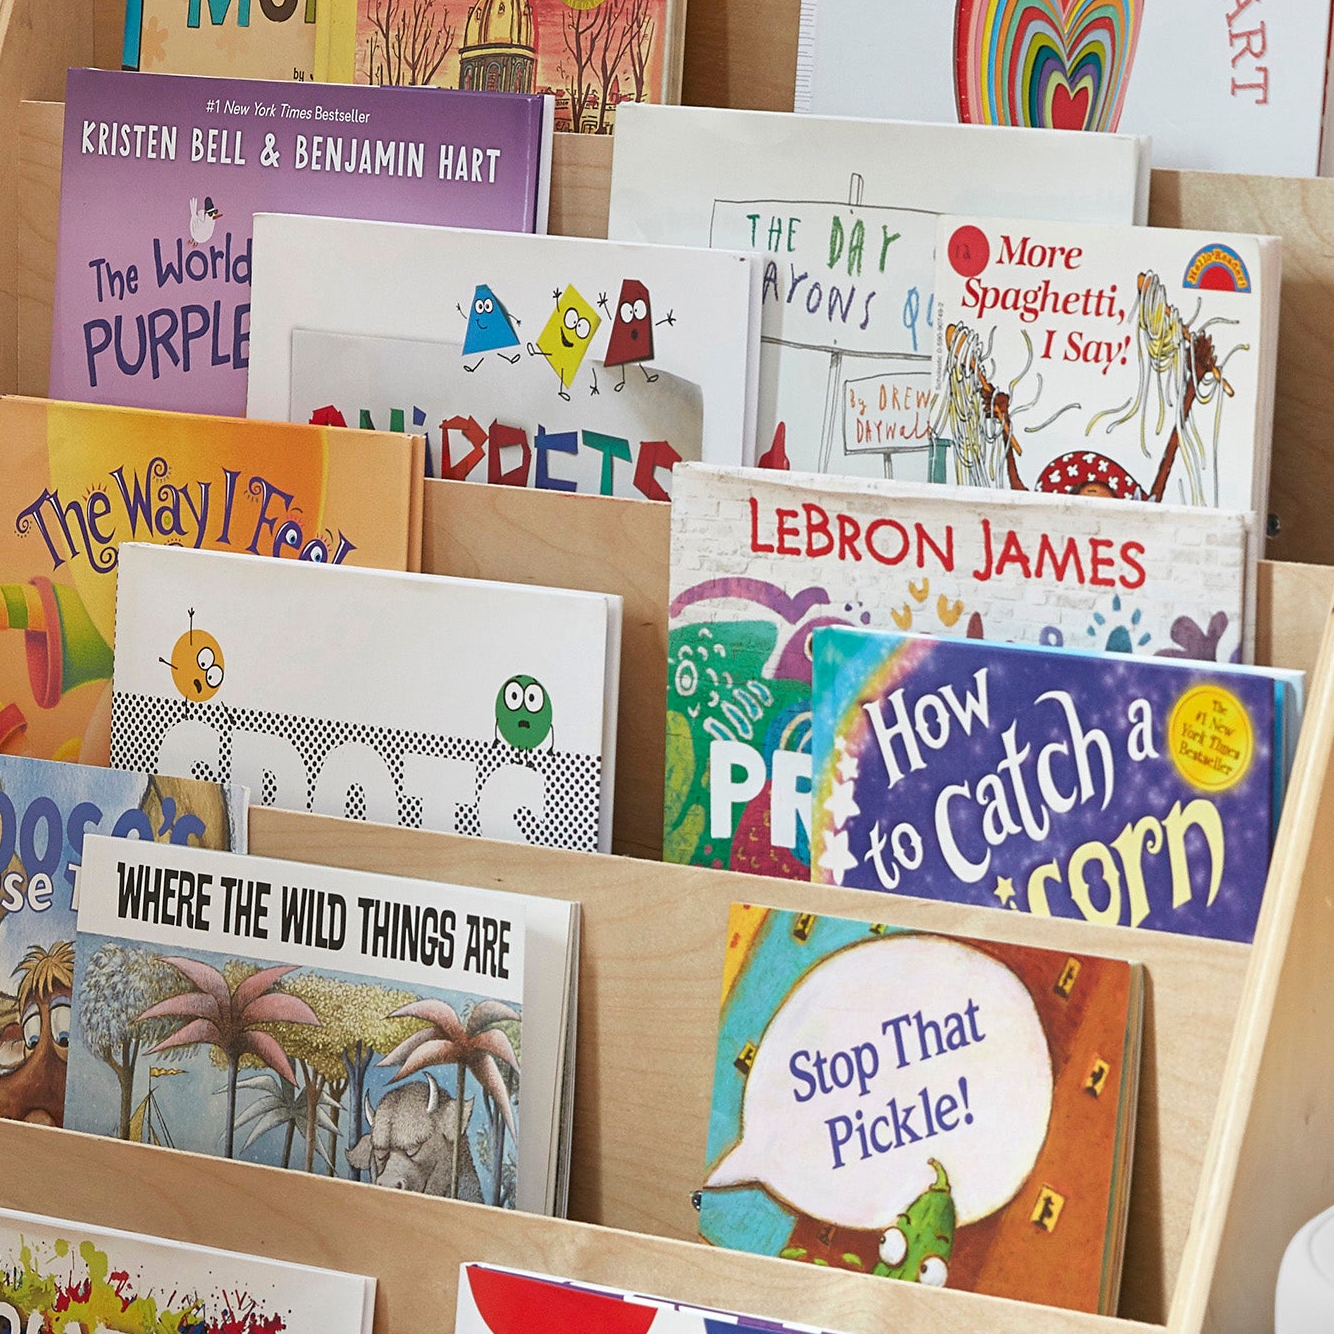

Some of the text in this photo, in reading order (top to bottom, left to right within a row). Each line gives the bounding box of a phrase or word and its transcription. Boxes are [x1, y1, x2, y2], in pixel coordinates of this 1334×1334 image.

[206, 99, 371, 124] #1 New York Times Bestseller
[293, 67, 305, 82] by
[81, 120, 501, 184] KRISTEN BELL & BENJAMIN HART
[89, 232, 253, 303] The World
[747, 214, 901, 276] THE DAY
[995, 235, 1083, 270] More
[961, 277, 1125, 325] Spaghetti,
[83, 299, 251, 387] PURPLE
[1040, 330, 1131, 375] I Say!
[878, 383, 931, 411] DREW
[16, 488, 117, 574] The
[109, 457, 212, 549] Way
[216, 467, 241, 544] I
[749, 497, 1147, 590] LEBRON JAMES
[862, 667, 991, 790] How
[864, 689, 1161, 890] to Catch a
[1009, 799, 1225, 929] corn
[116, 861, 211, 932] WHERE
[219, 875, 269, 940] THE
[280, 883, 348, 952] WILD
[357, 896, 456, 968] THINGS
[464, 912, 511, 980] ARE
[789, 998, 986, 1102] Stop That
[824, 1076, 975, 1170] Pickle!
